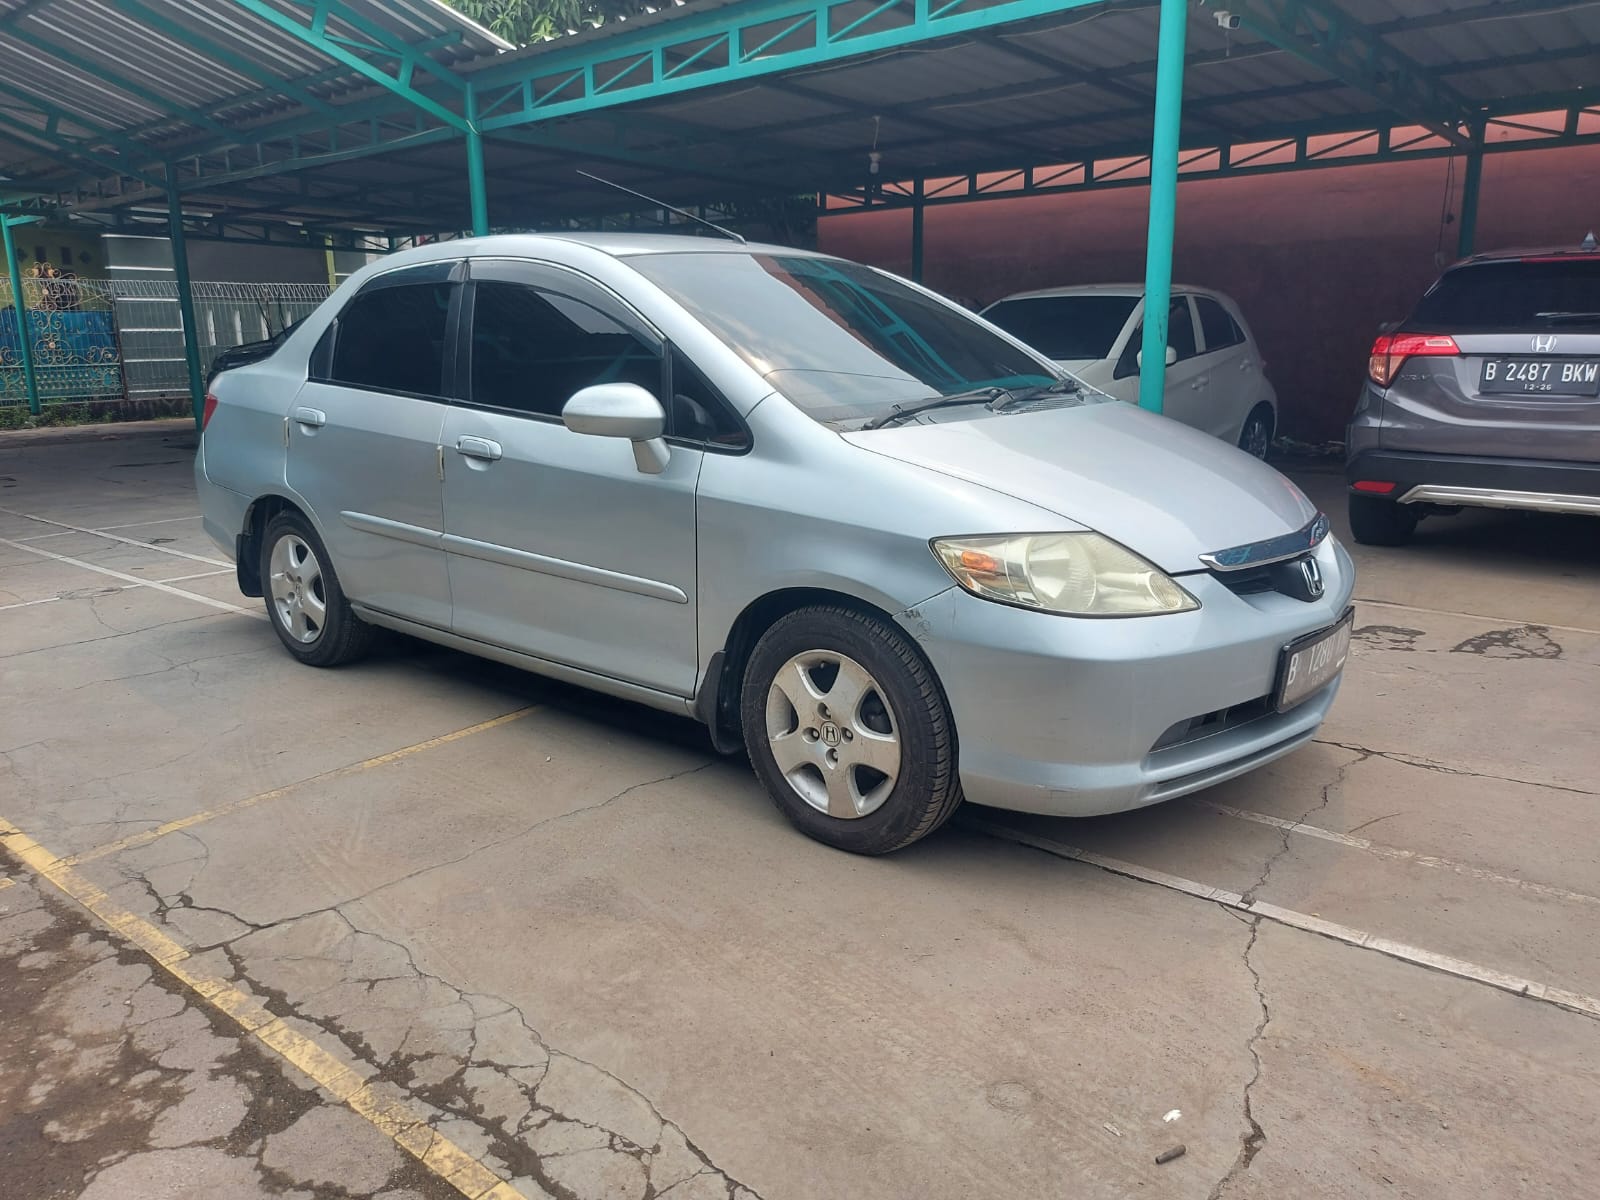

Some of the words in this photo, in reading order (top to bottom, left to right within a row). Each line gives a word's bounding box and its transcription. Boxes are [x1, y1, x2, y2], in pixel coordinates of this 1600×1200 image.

[1485, 362, 1497, 381] B
[1505, 363, 1552, 381] 2487
[1561, 363, 1598, 382] BKW
[1287, 652, 1299, 686] B
